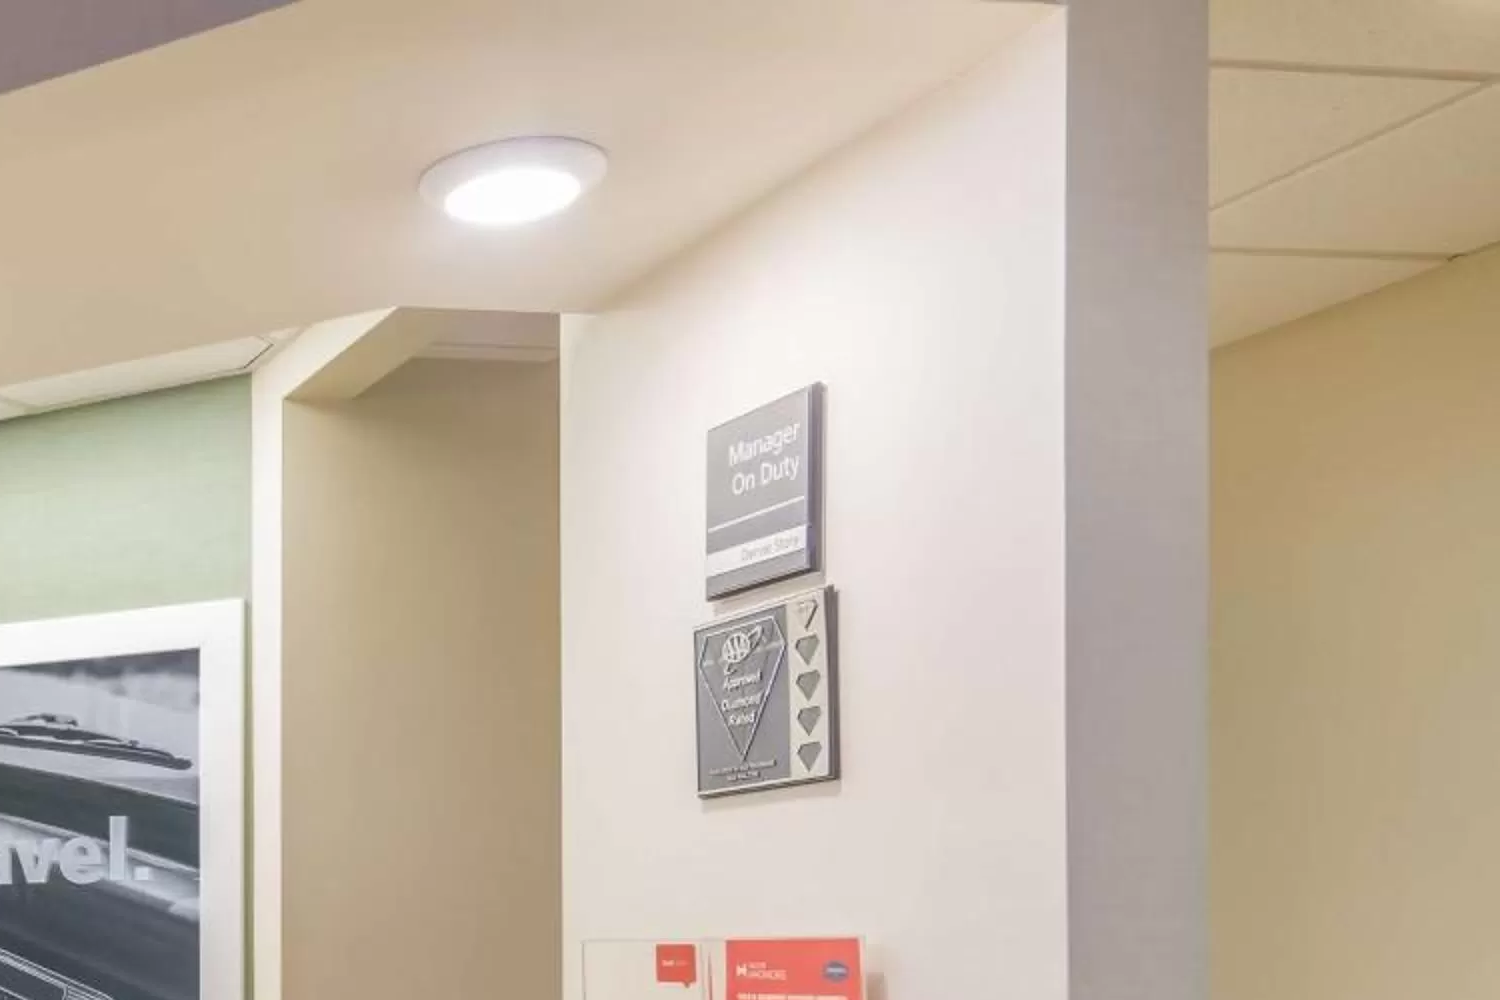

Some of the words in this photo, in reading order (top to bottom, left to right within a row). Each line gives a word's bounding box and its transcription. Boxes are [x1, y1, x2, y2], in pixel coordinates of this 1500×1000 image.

[728, 422, 800, 467] Manager
[731, 472, 755, 496] On
[760, 454, 800, 486] Duty
